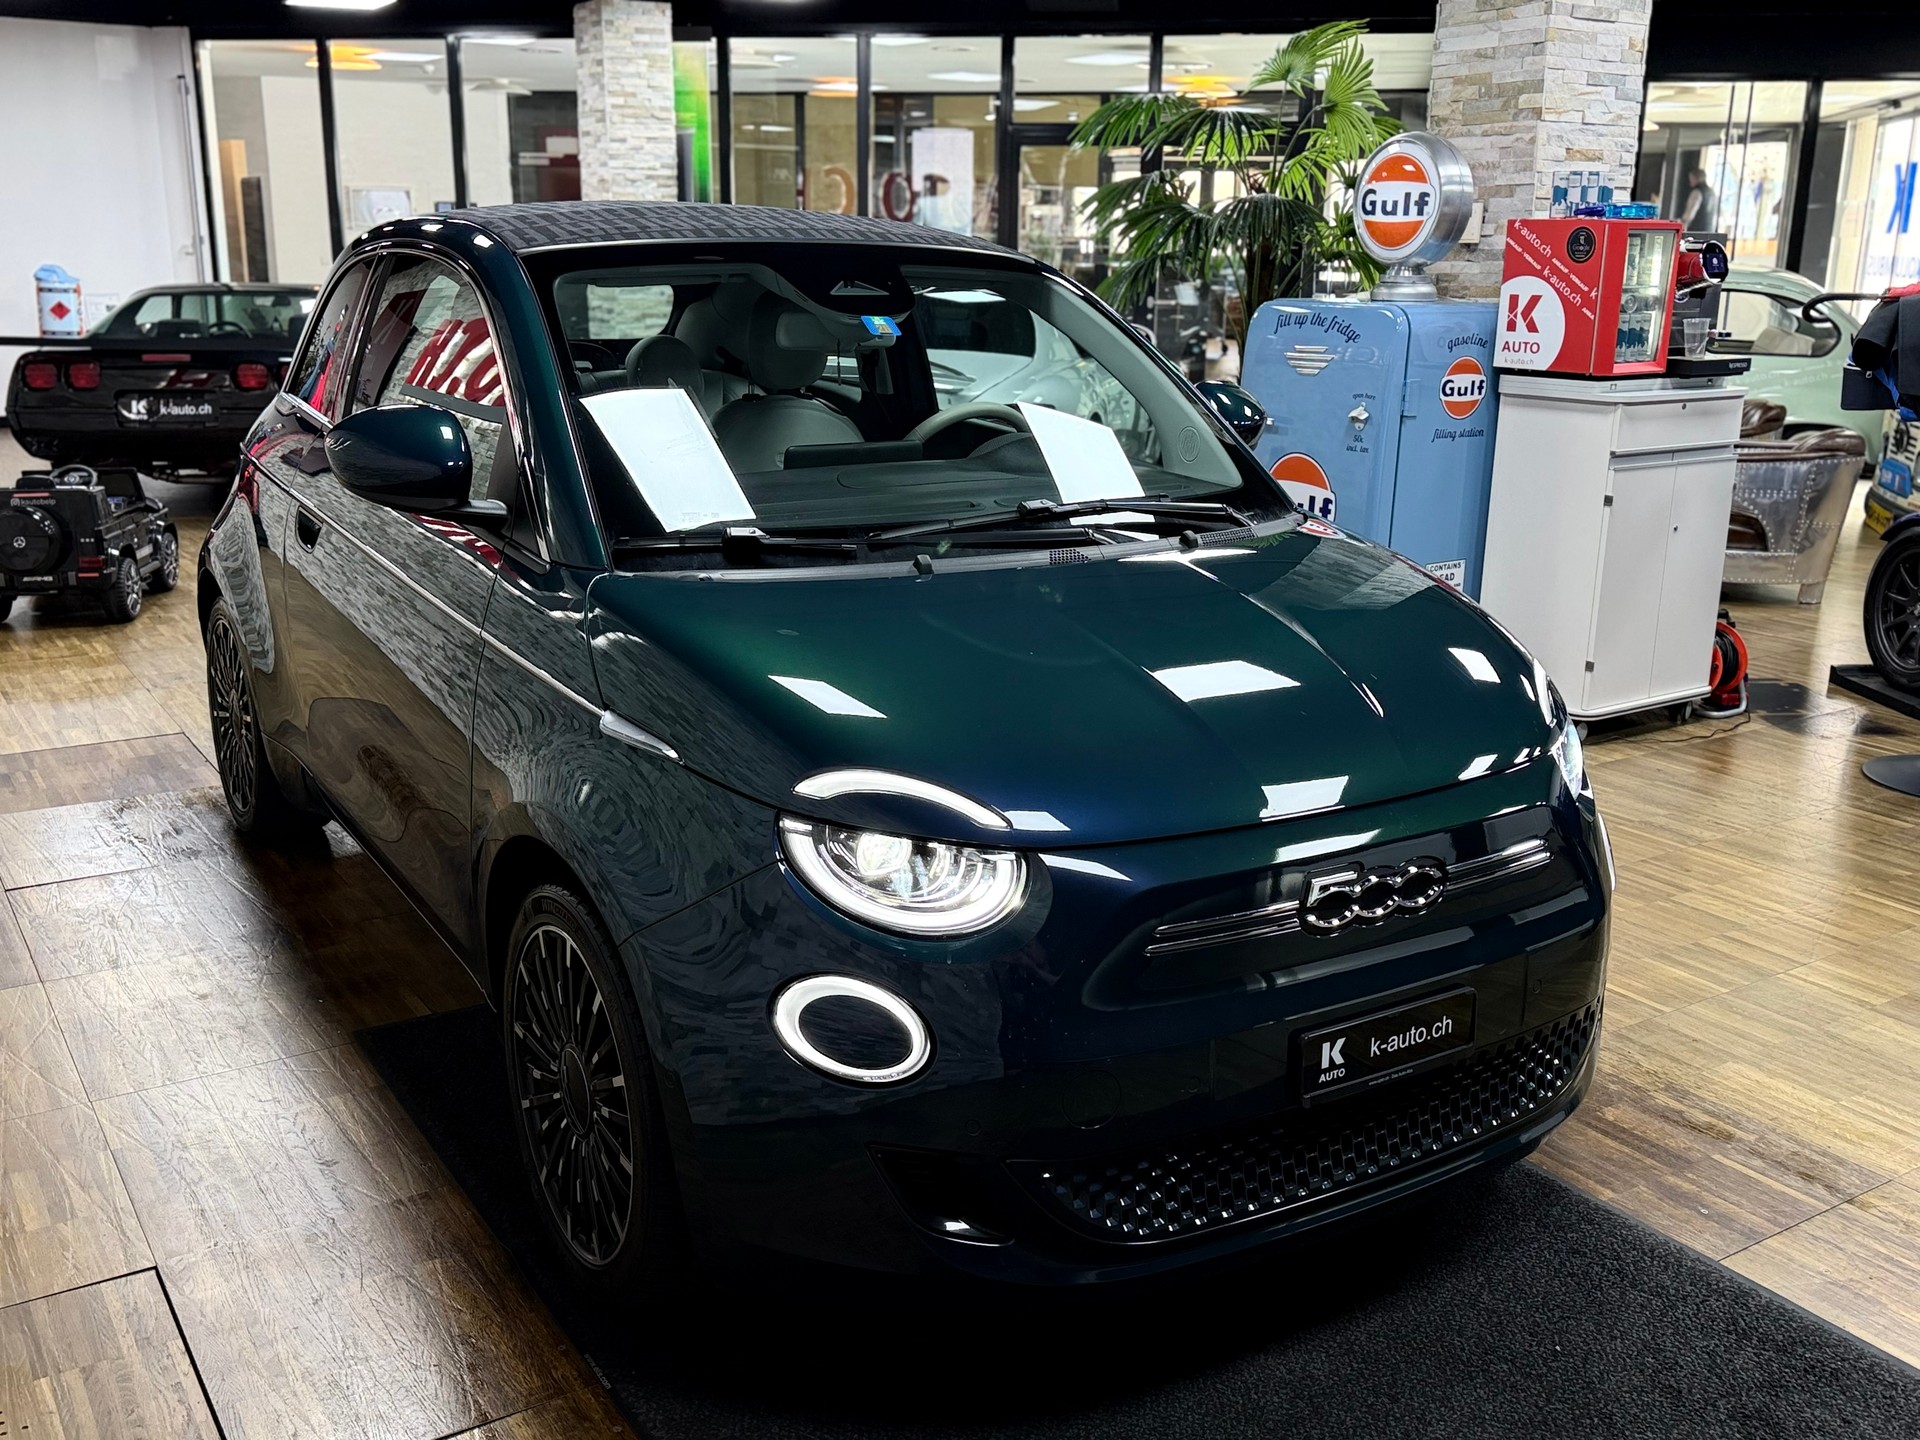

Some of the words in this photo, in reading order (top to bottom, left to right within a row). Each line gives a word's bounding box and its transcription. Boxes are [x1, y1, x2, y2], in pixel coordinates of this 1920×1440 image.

[1361, 188, 1430, 217] Gulf
[1513, 219, 1552, 258] k-auto.ch
[1551, 257, 1570, 273] ANKAUF
[1569, 273, 1590, 291] VERKAUF
[1523, 251, 1542, 270] VERKAUF
[1543, 265, 1582, 307] k-auto.ch
[1506, 294, 1543, 333] K
[1274, 313, 1292, 335] fill
[1294, 314, 1308, 329] up
[1309, 312, 1328, 327] the
[1324, 315, 1361, 343] fridge
[1447, 333, 1488, 353] gasoline
[1501, 341, 1541, 354] AUTO
[1504, 357, 1534, 365] k-auto.ch
[1441, 379, 1485, 397] Gulf
[160, 402, 212, 415] k-auto.ch
[1431, 428, 1457, 443] filling
[1458, 427, 1484, 438] station
[1430, 561, 1461, 573] CONTAINS
[1304, 863, 1447, 929] 500
[1370, 1015, 1452, 1057] k-auto.ch
[1321, 1037, 1347, 1070] K
[1318, 1068, 1346, 1083] AUTO
